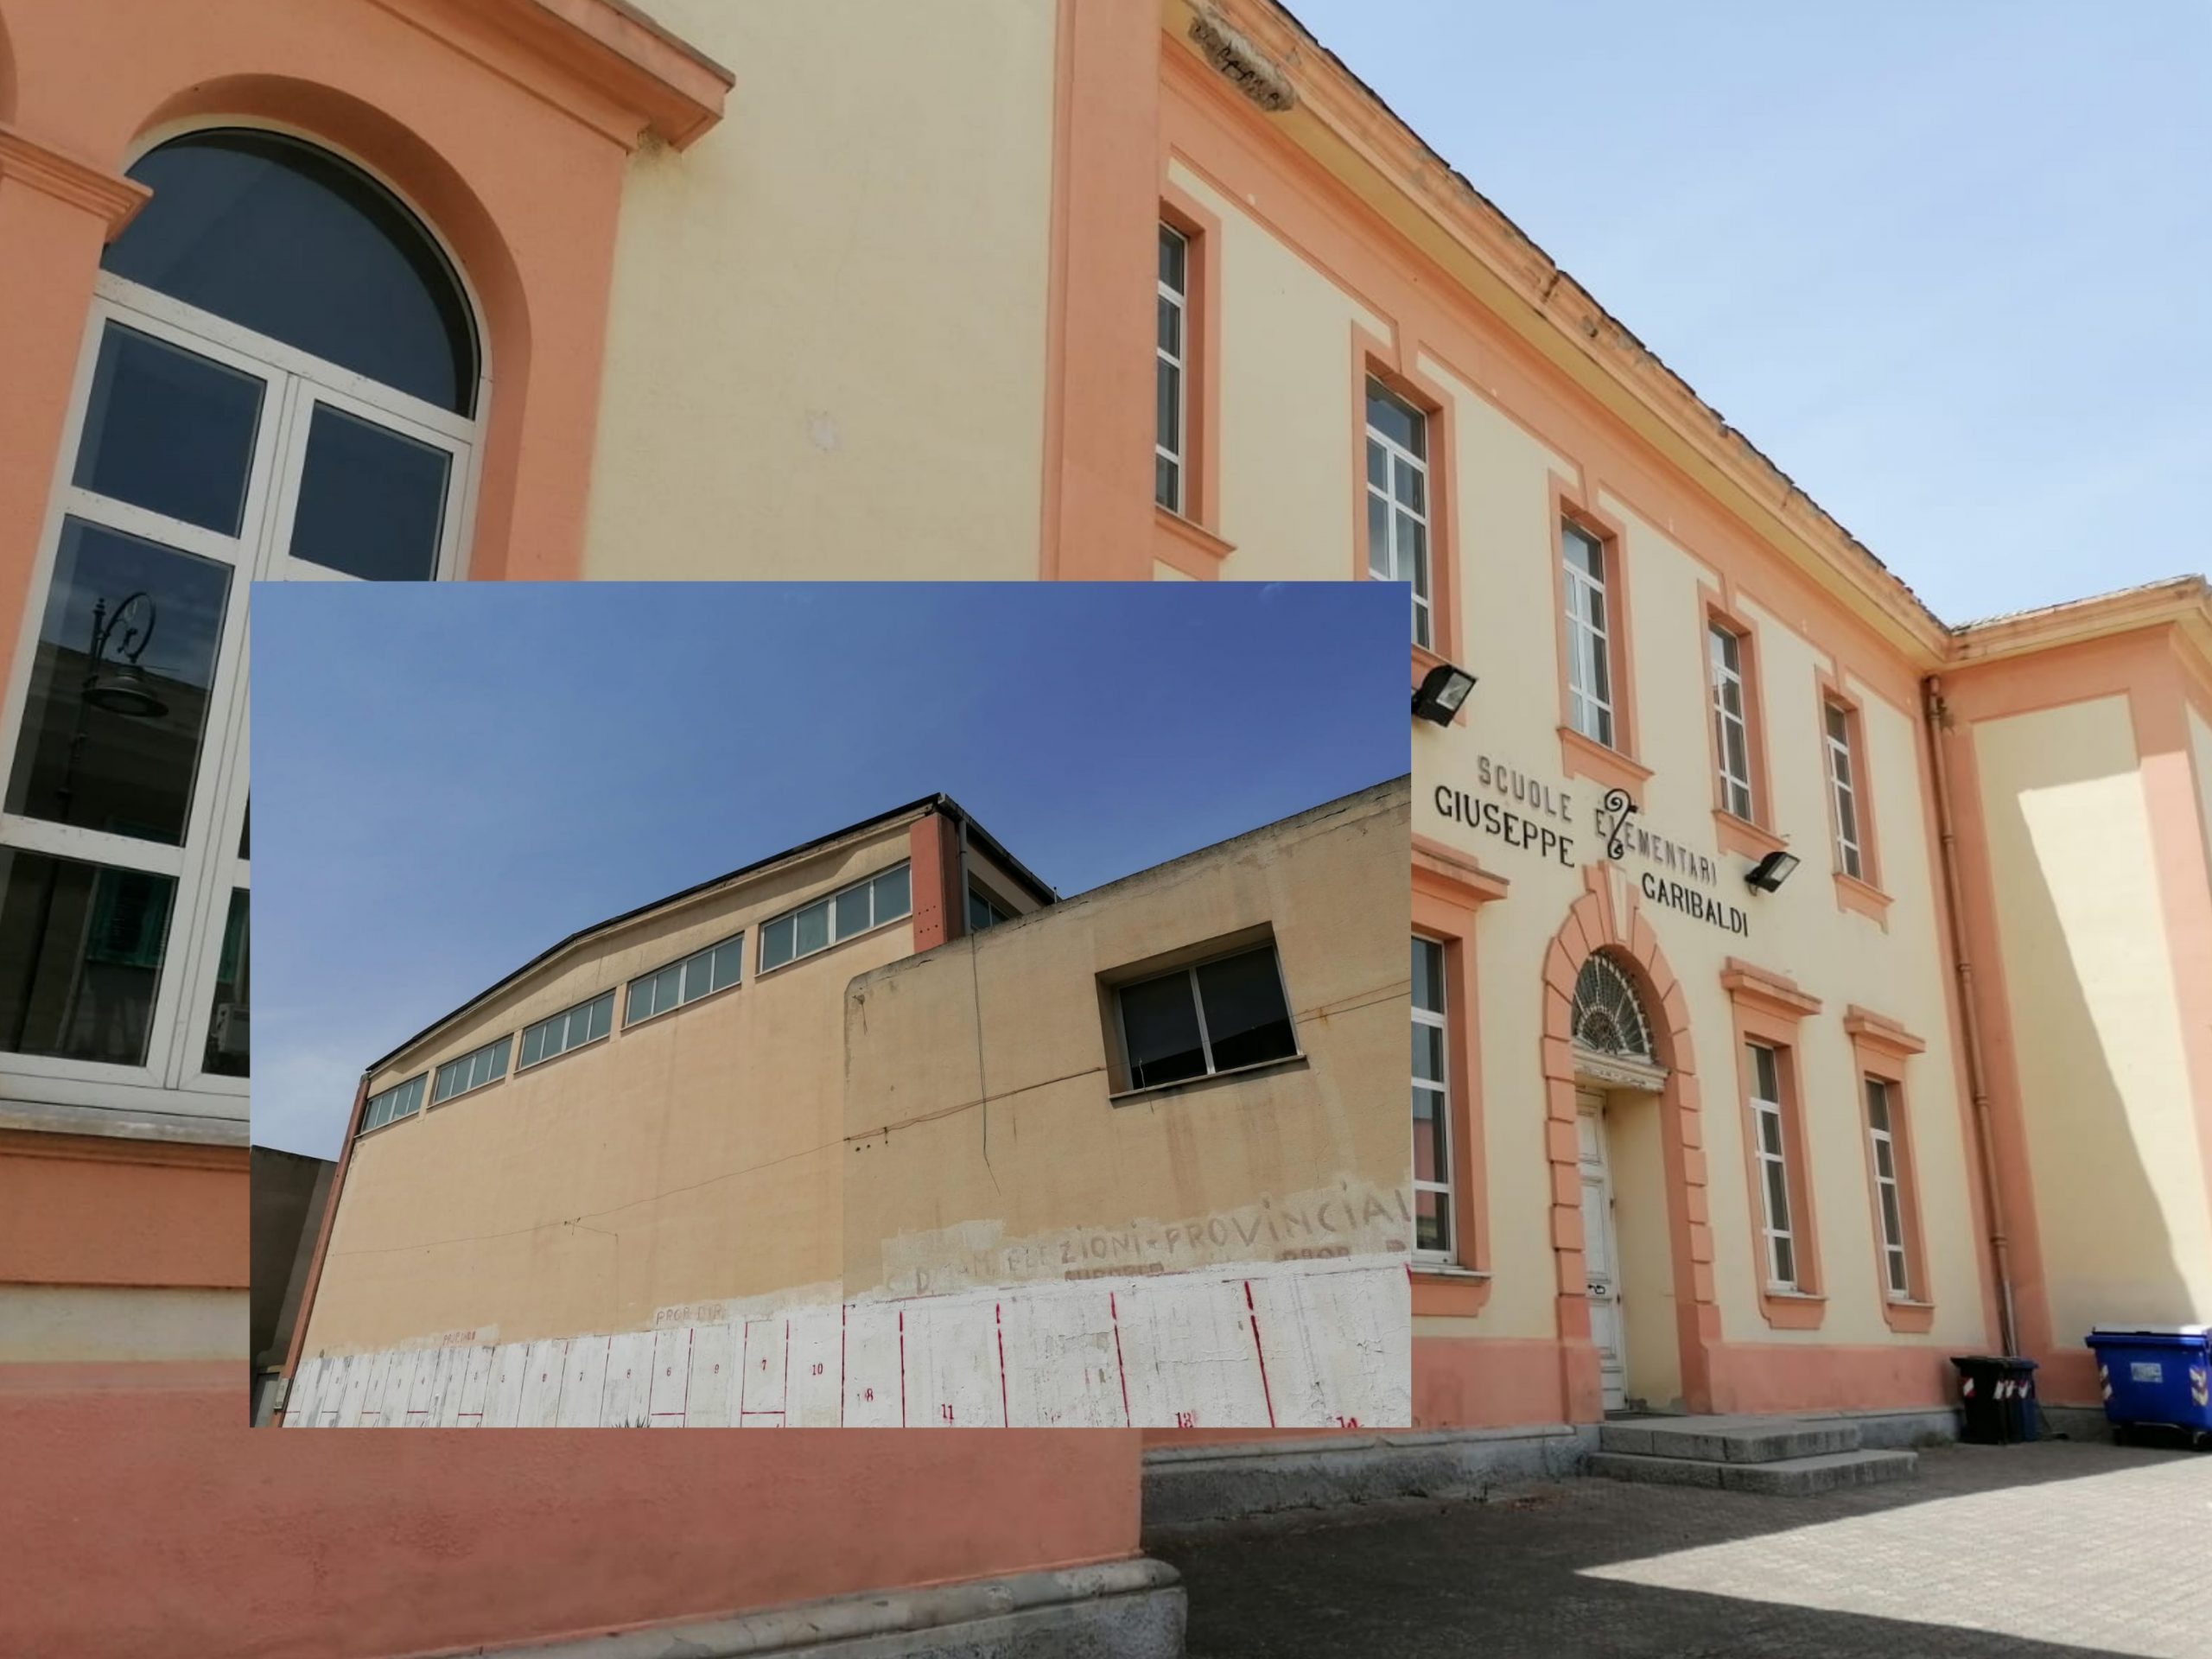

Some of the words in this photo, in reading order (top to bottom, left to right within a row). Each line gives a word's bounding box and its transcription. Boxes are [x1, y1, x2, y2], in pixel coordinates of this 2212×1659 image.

[1478, 755, 1573, 822] SCUOLE
[1594, 808, 1718, 887] ELEMENTARI
[1435, 785, 1574, 868] GIUSEPPE
[1642, 873, 1748, 938] GARIBALDI
[761, 1359, 767, 1371] 7
[812, 1363, 823, 1376] 10
[941, 1403, 955, 1420] 11
